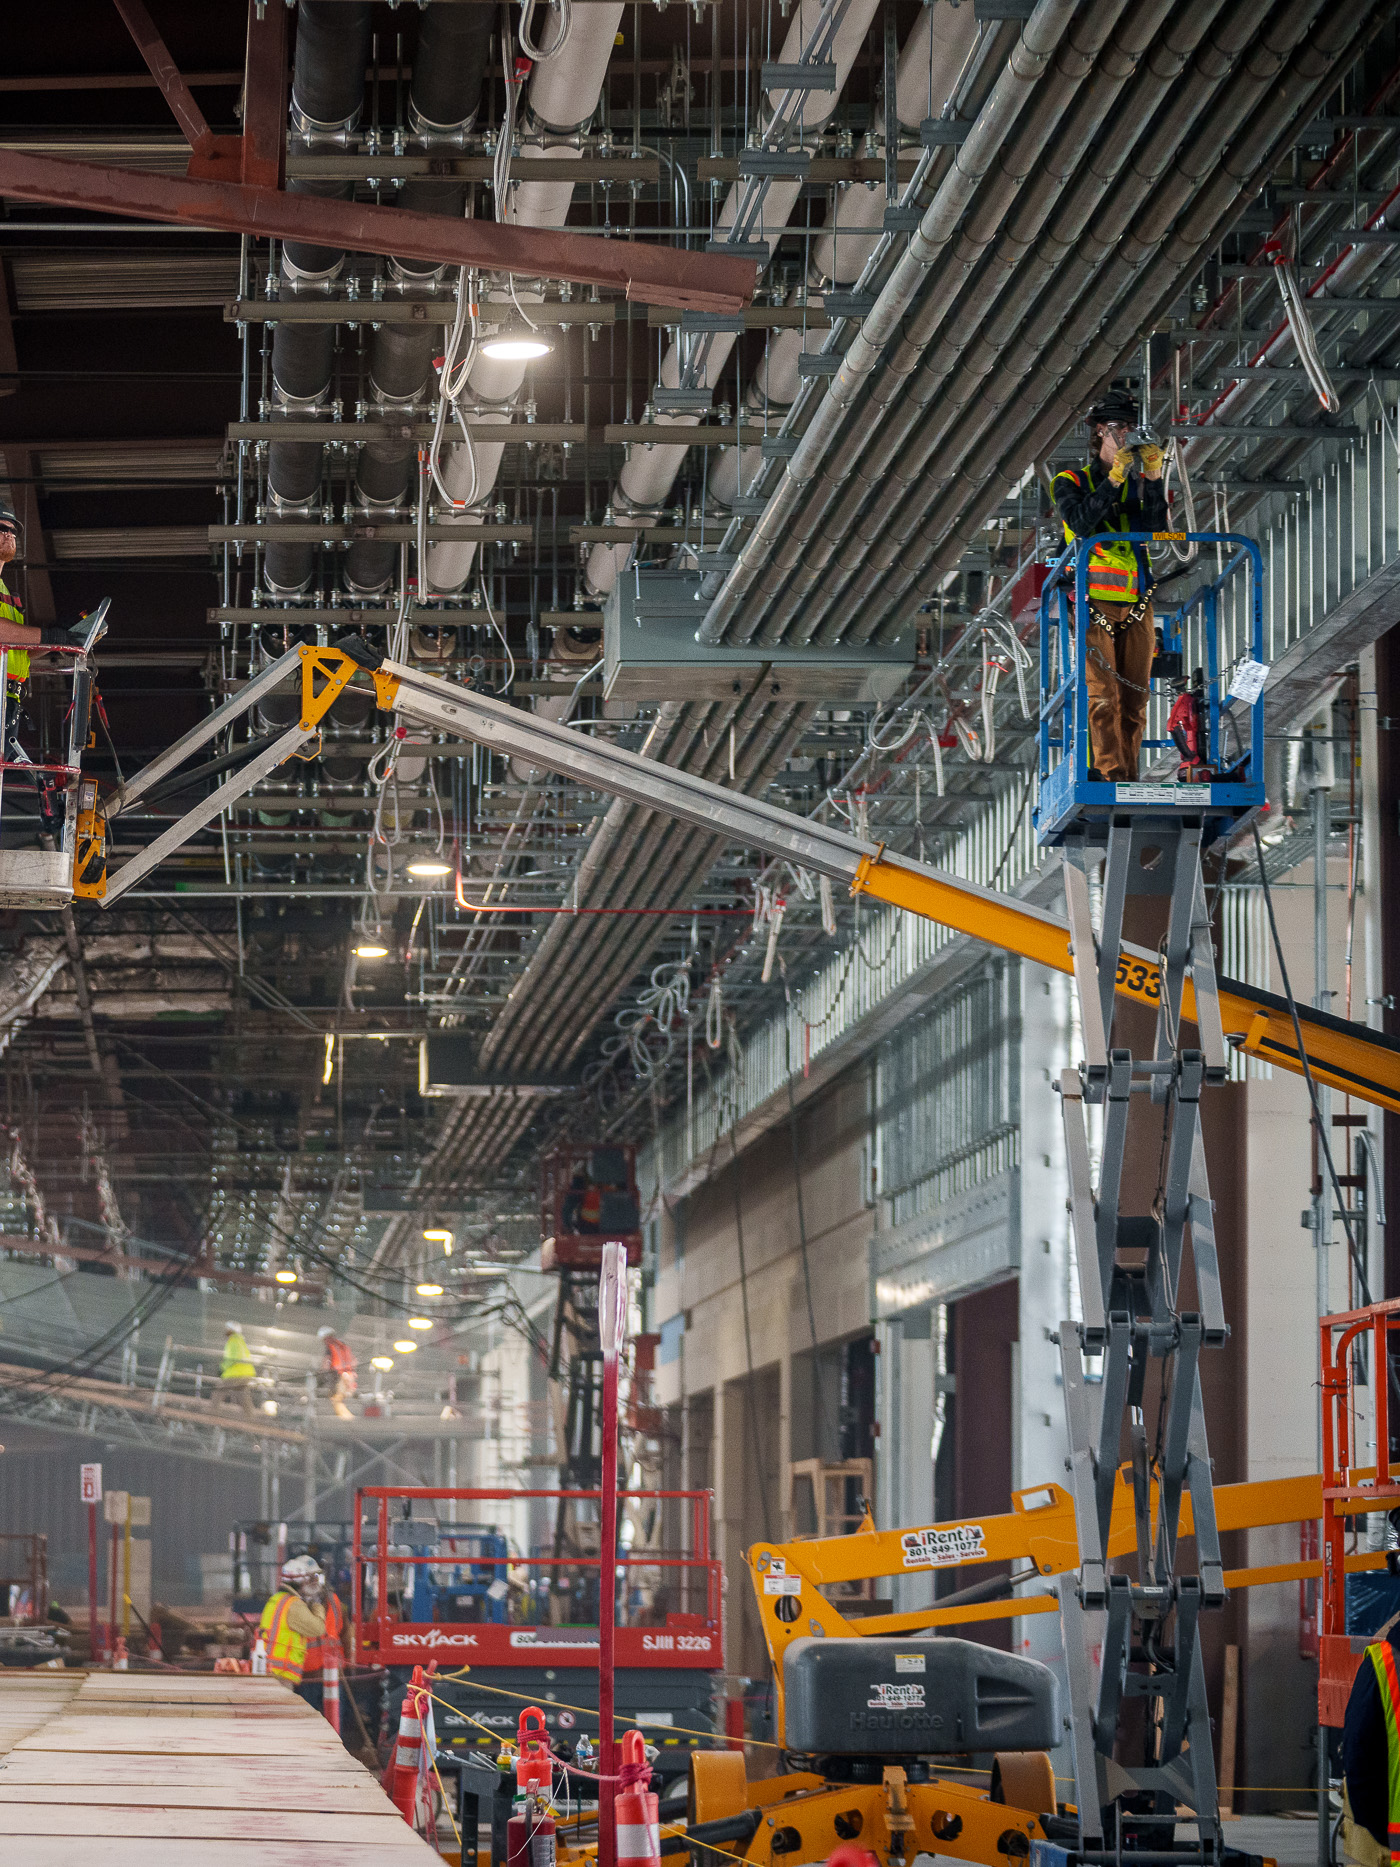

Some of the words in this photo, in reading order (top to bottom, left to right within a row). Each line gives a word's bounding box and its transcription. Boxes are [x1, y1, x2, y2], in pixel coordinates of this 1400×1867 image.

[1154, 532, 1185, 540] WILSON
[1115, 957, 1160, 998] 533
[921, 1529, 963, 1546] iRent
[905, 1555, 931, 1564] Rentals
[937, 1553, 955, 1561] Sales
[960, 1550, 985, 1558] Service
[909, 1541, 978, 1557] 801-849-1077
[392, 1629, 479, 1648] SKYJACK
[677, 1636, 711, 1651] 3226
[881, 1685, 911, 1695] iRent
[849, 1712, 945, 1730] Haulotte
